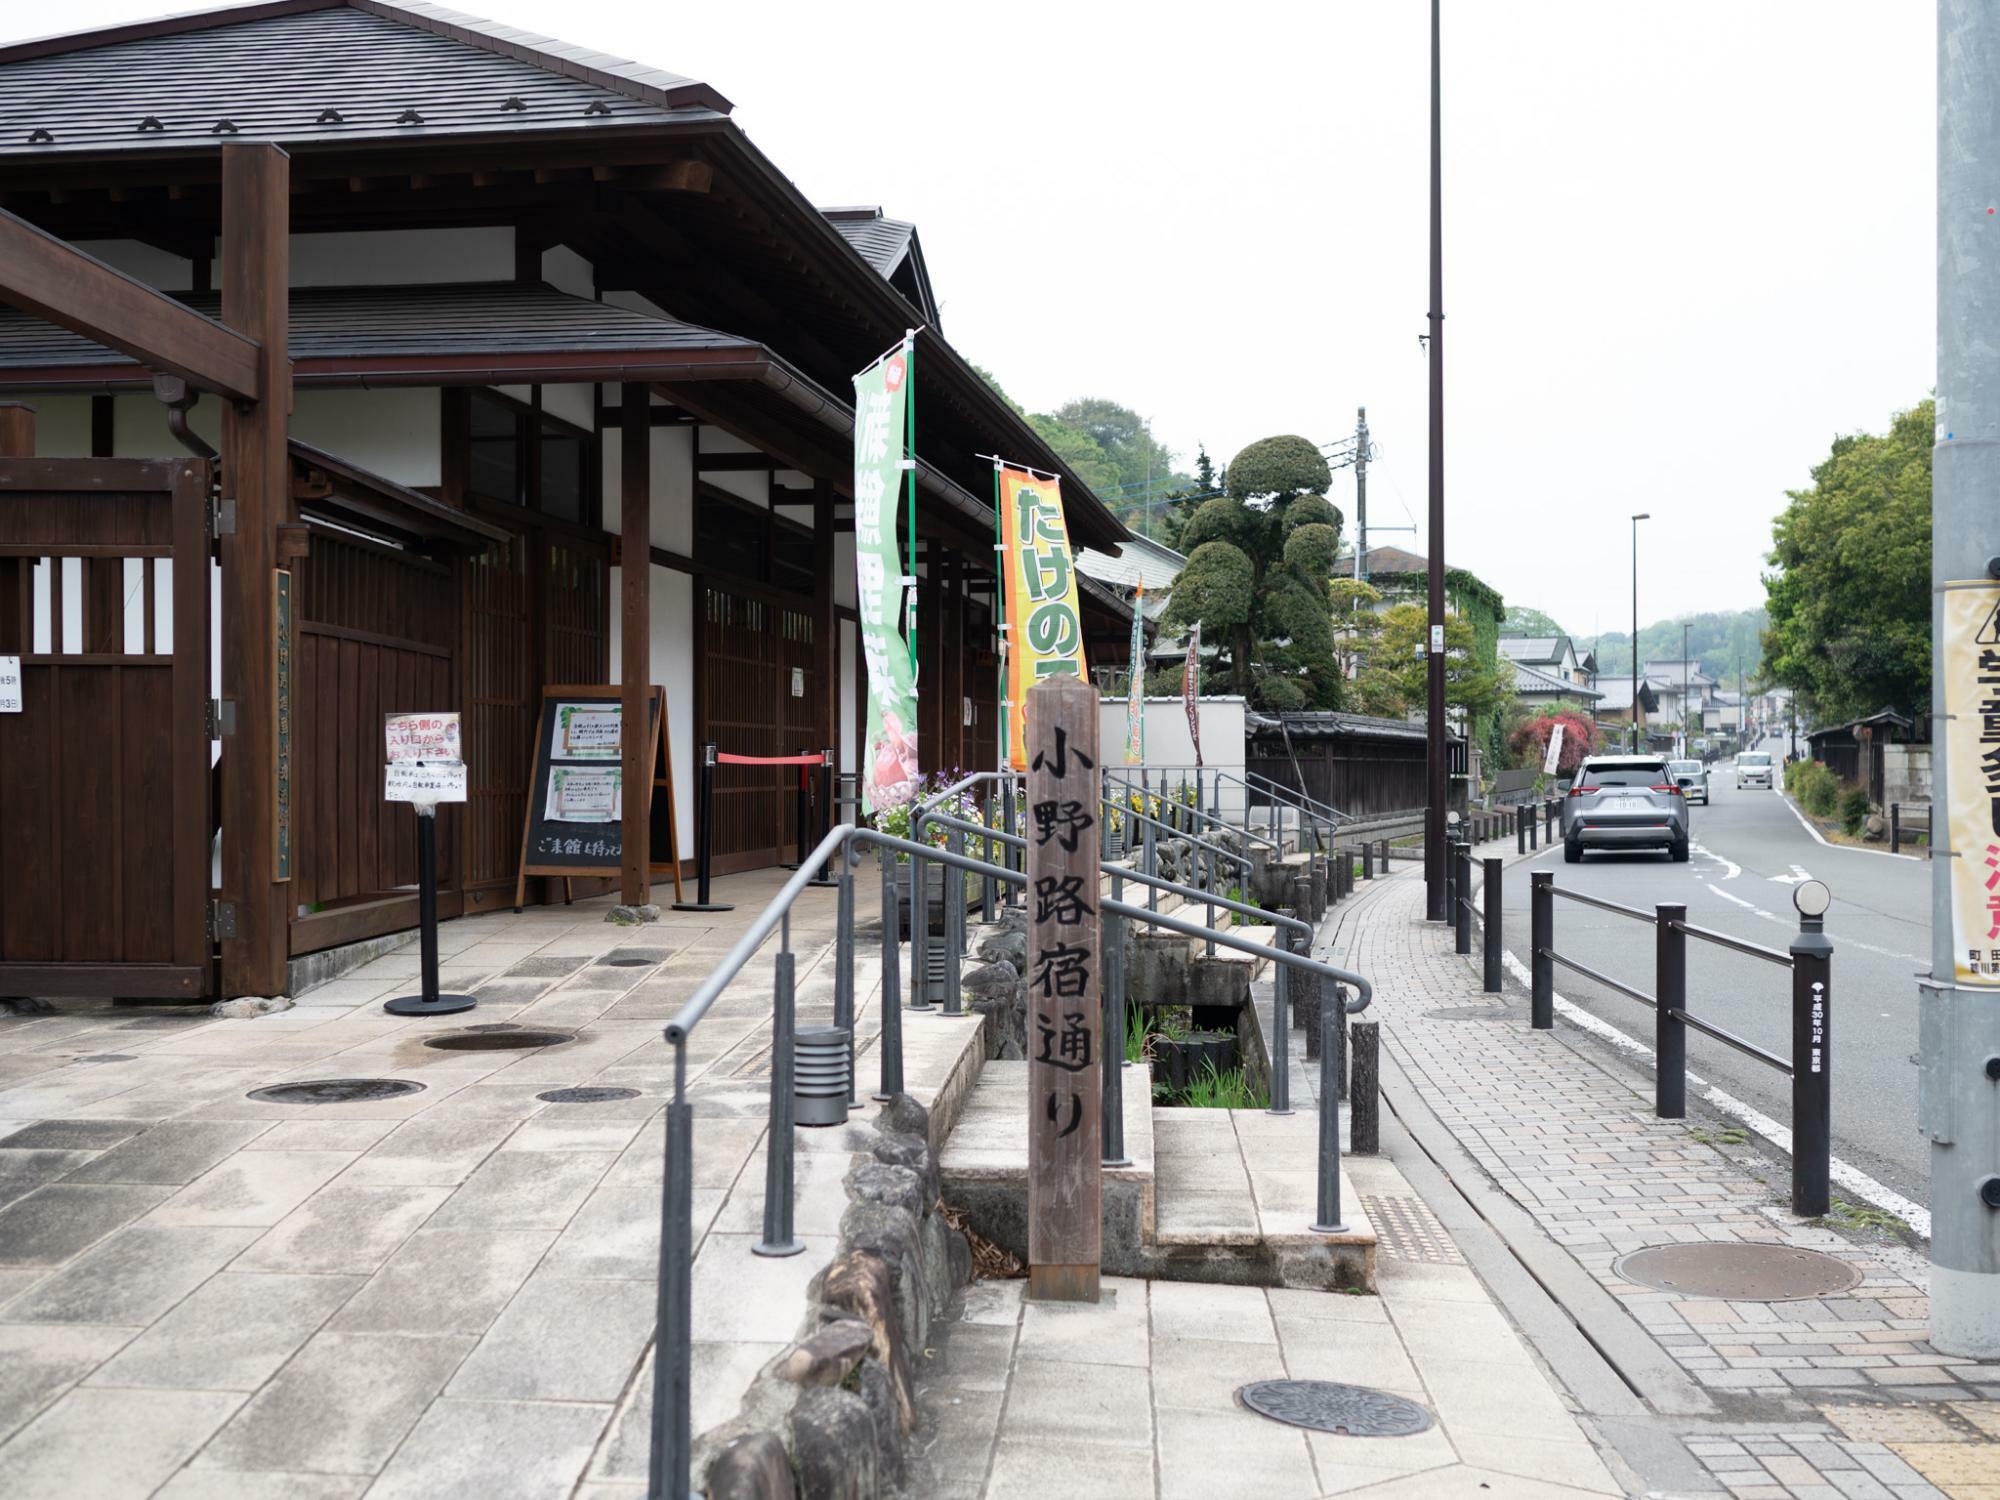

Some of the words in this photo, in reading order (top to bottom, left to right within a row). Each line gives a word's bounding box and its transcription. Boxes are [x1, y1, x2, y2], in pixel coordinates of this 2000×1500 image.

[1031, 726, 1094, 1139] 小野路宿通り
